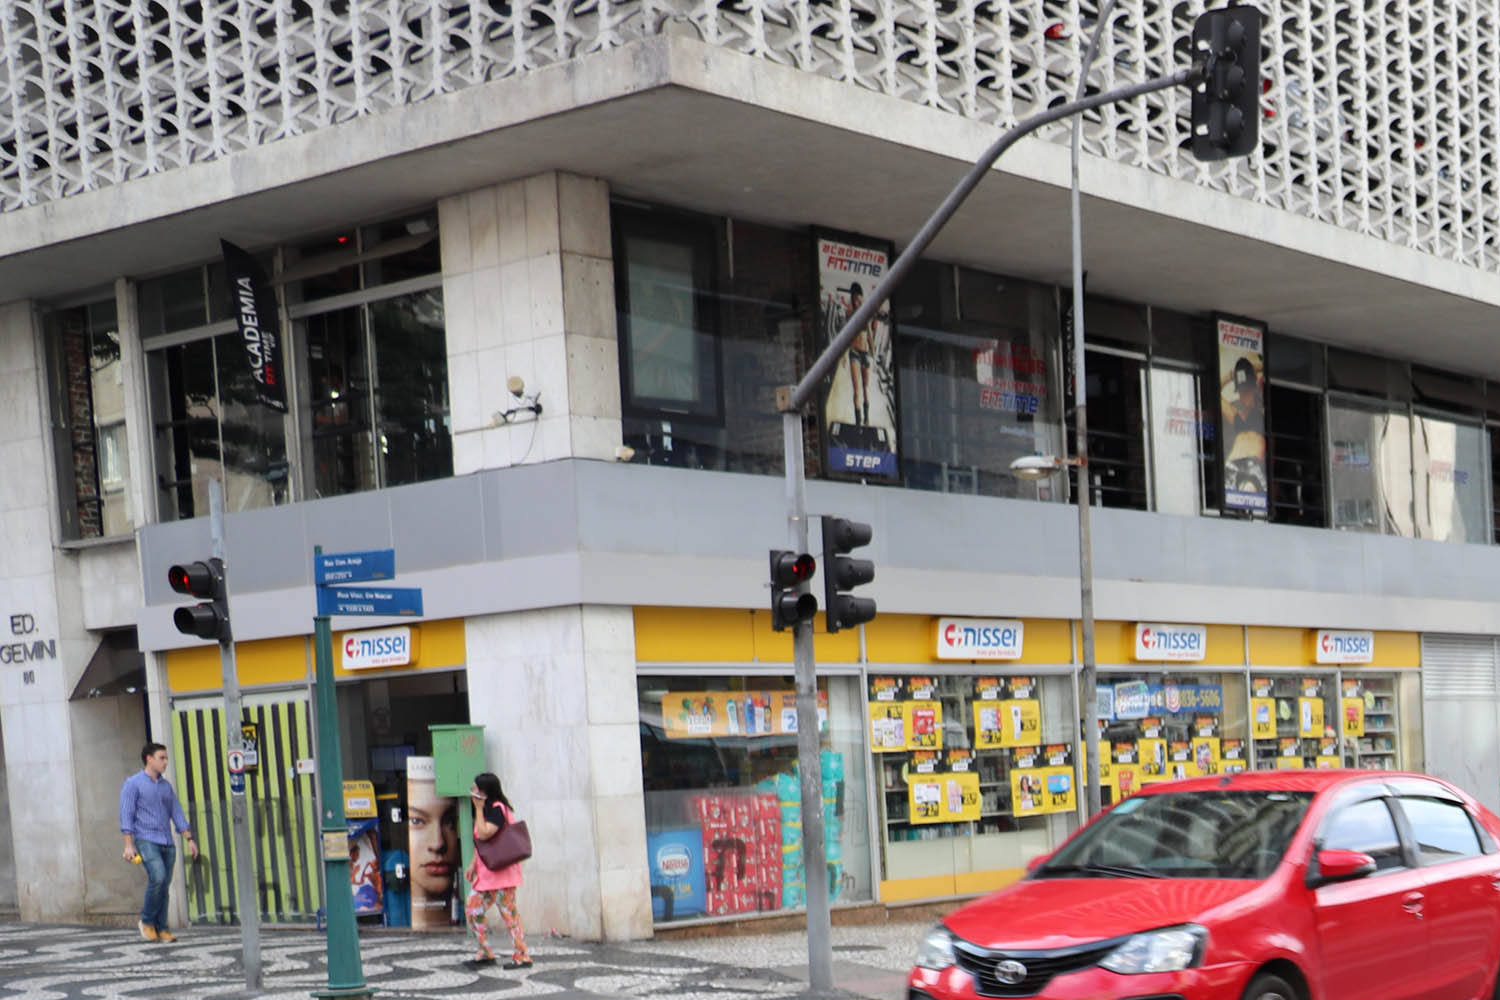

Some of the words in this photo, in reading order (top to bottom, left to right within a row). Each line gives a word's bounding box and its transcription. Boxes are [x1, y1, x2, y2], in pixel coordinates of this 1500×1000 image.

[237, 276, 264, 384] ACADEMIA
[10, 614, 39, 635] ED.
[360, 636, 406, 656] nissei
[964, 627, 1017, 647] nissei
[1156, 631, 1201, 649] nissei
[1335, 636, 1369, 653] nissei
[0, 639, 56, 664] GEMINI
